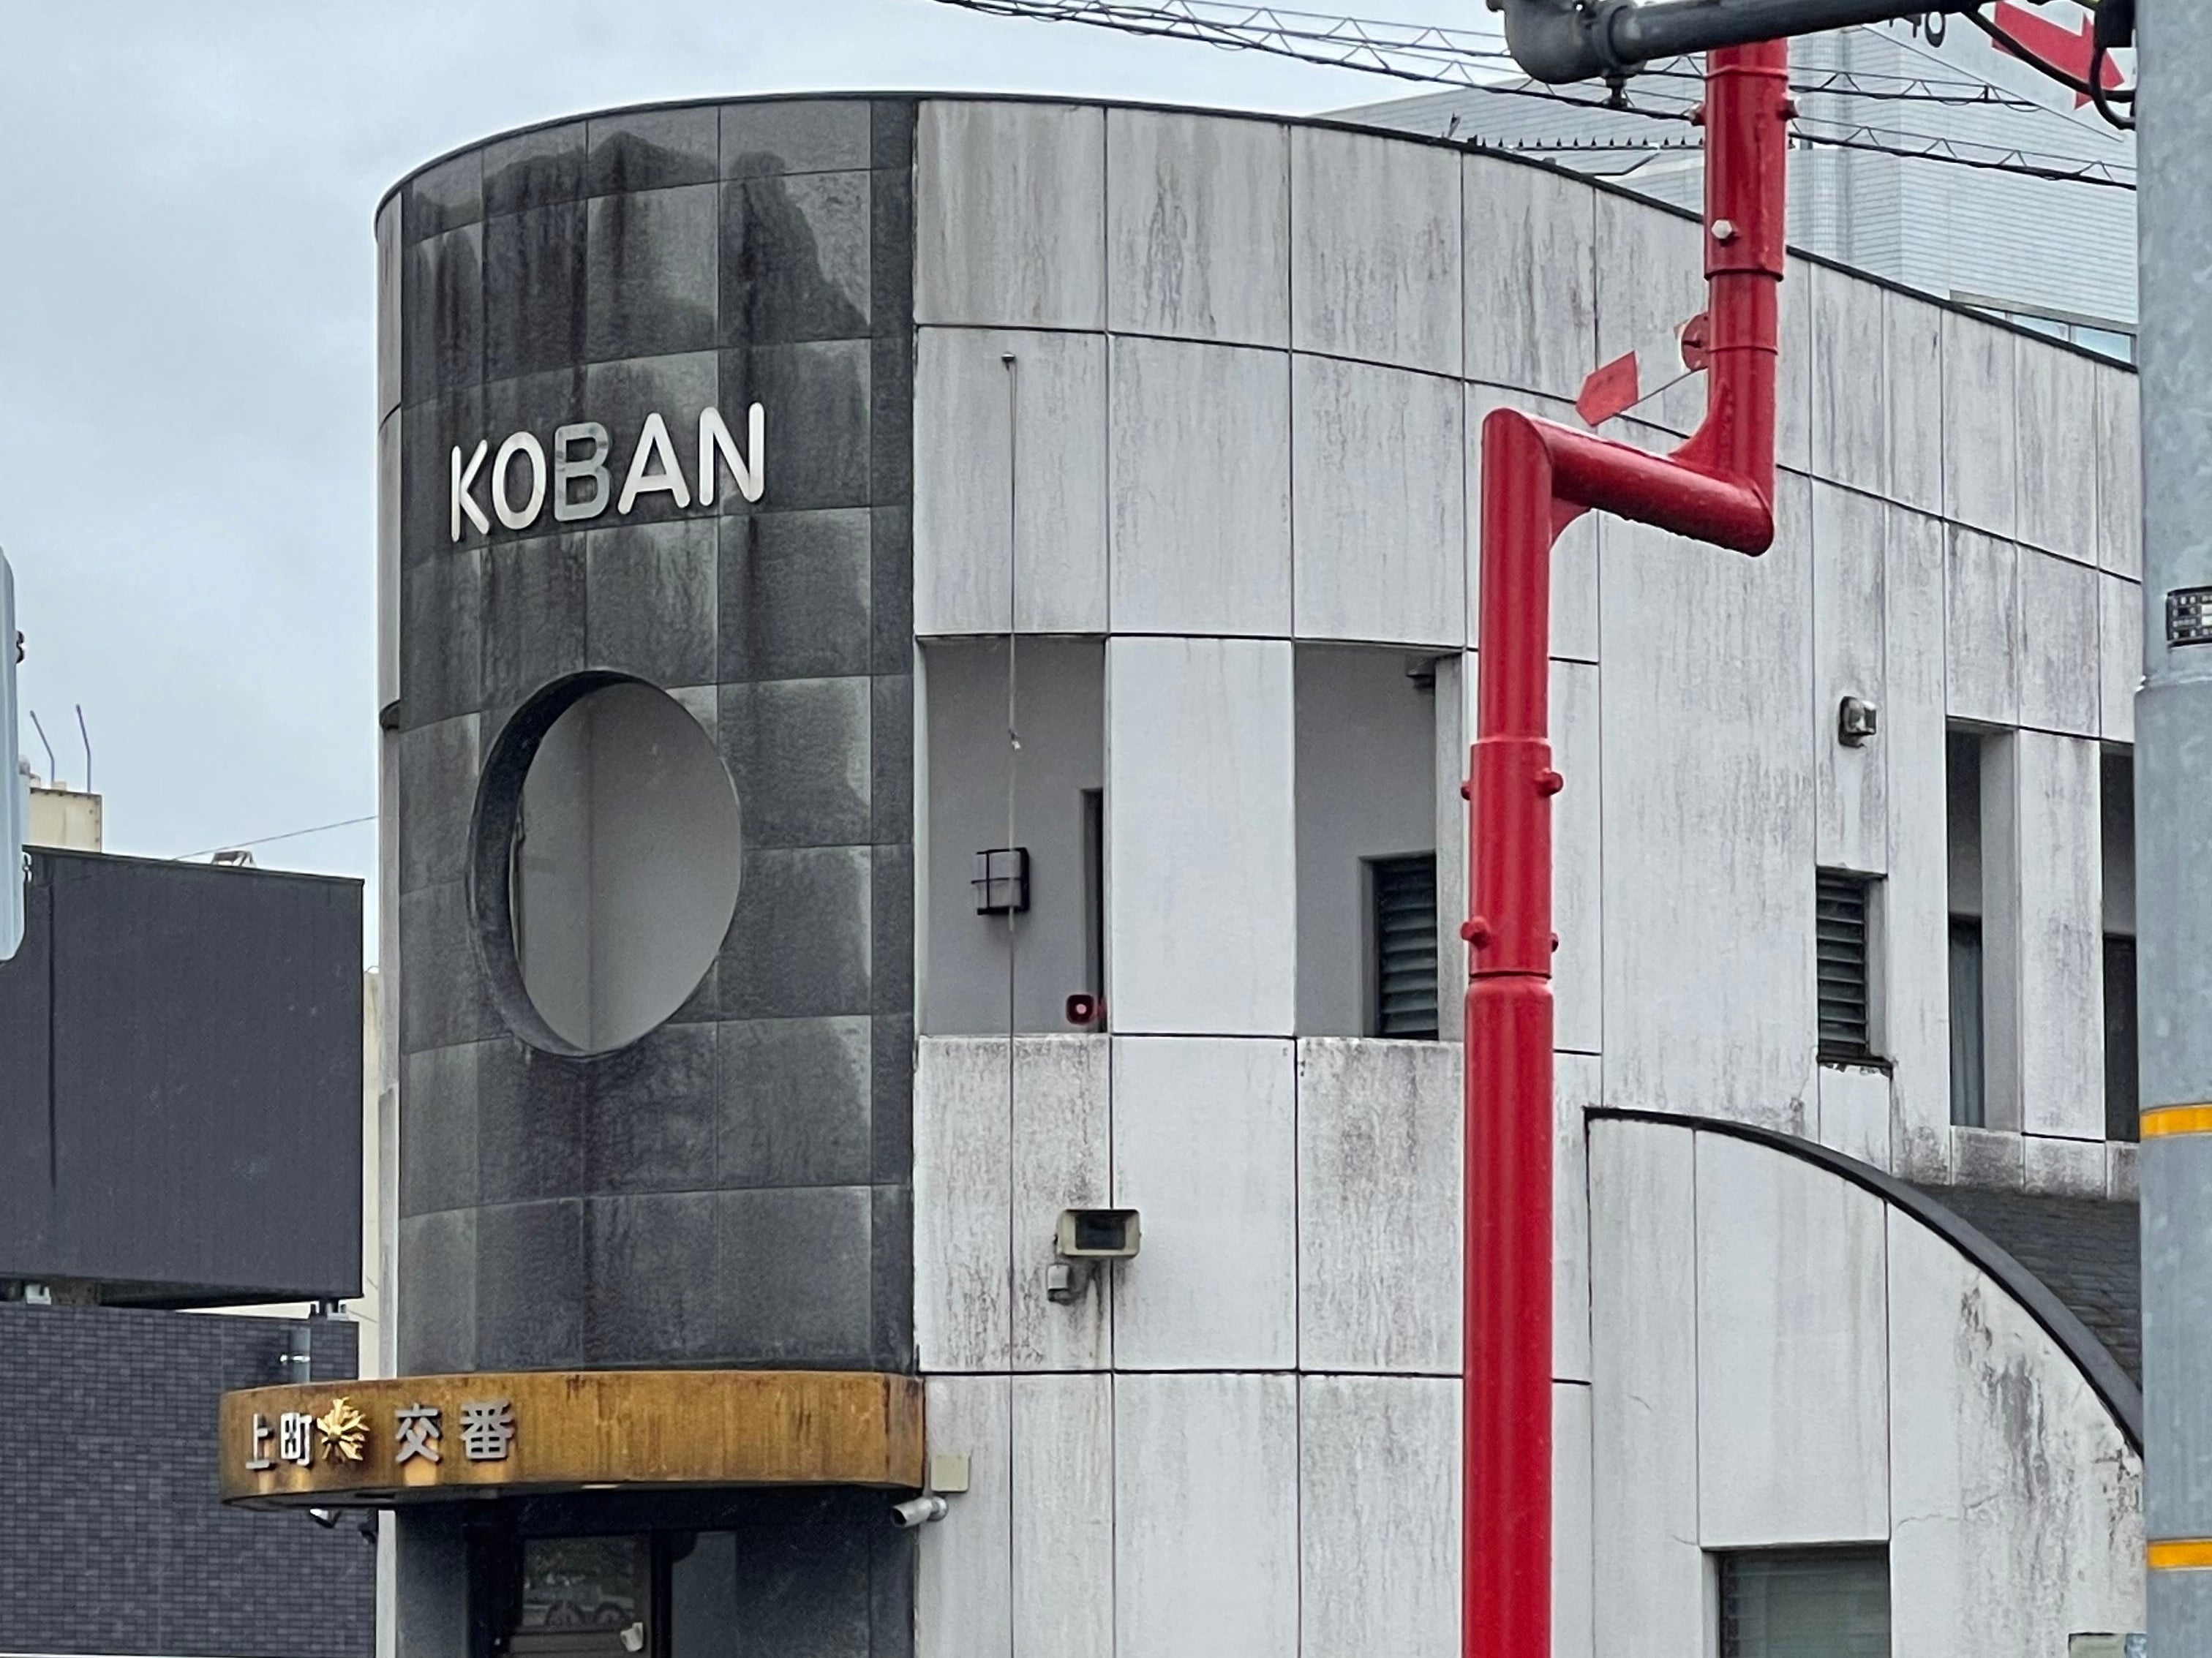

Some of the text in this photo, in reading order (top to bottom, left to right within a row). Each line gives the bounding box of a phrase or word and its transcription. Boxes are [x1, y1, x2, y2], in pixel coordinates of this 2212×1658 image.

[451, 402, 765, 543] KOBAN
[245, 1400, 515, 1469] 上町 交番
